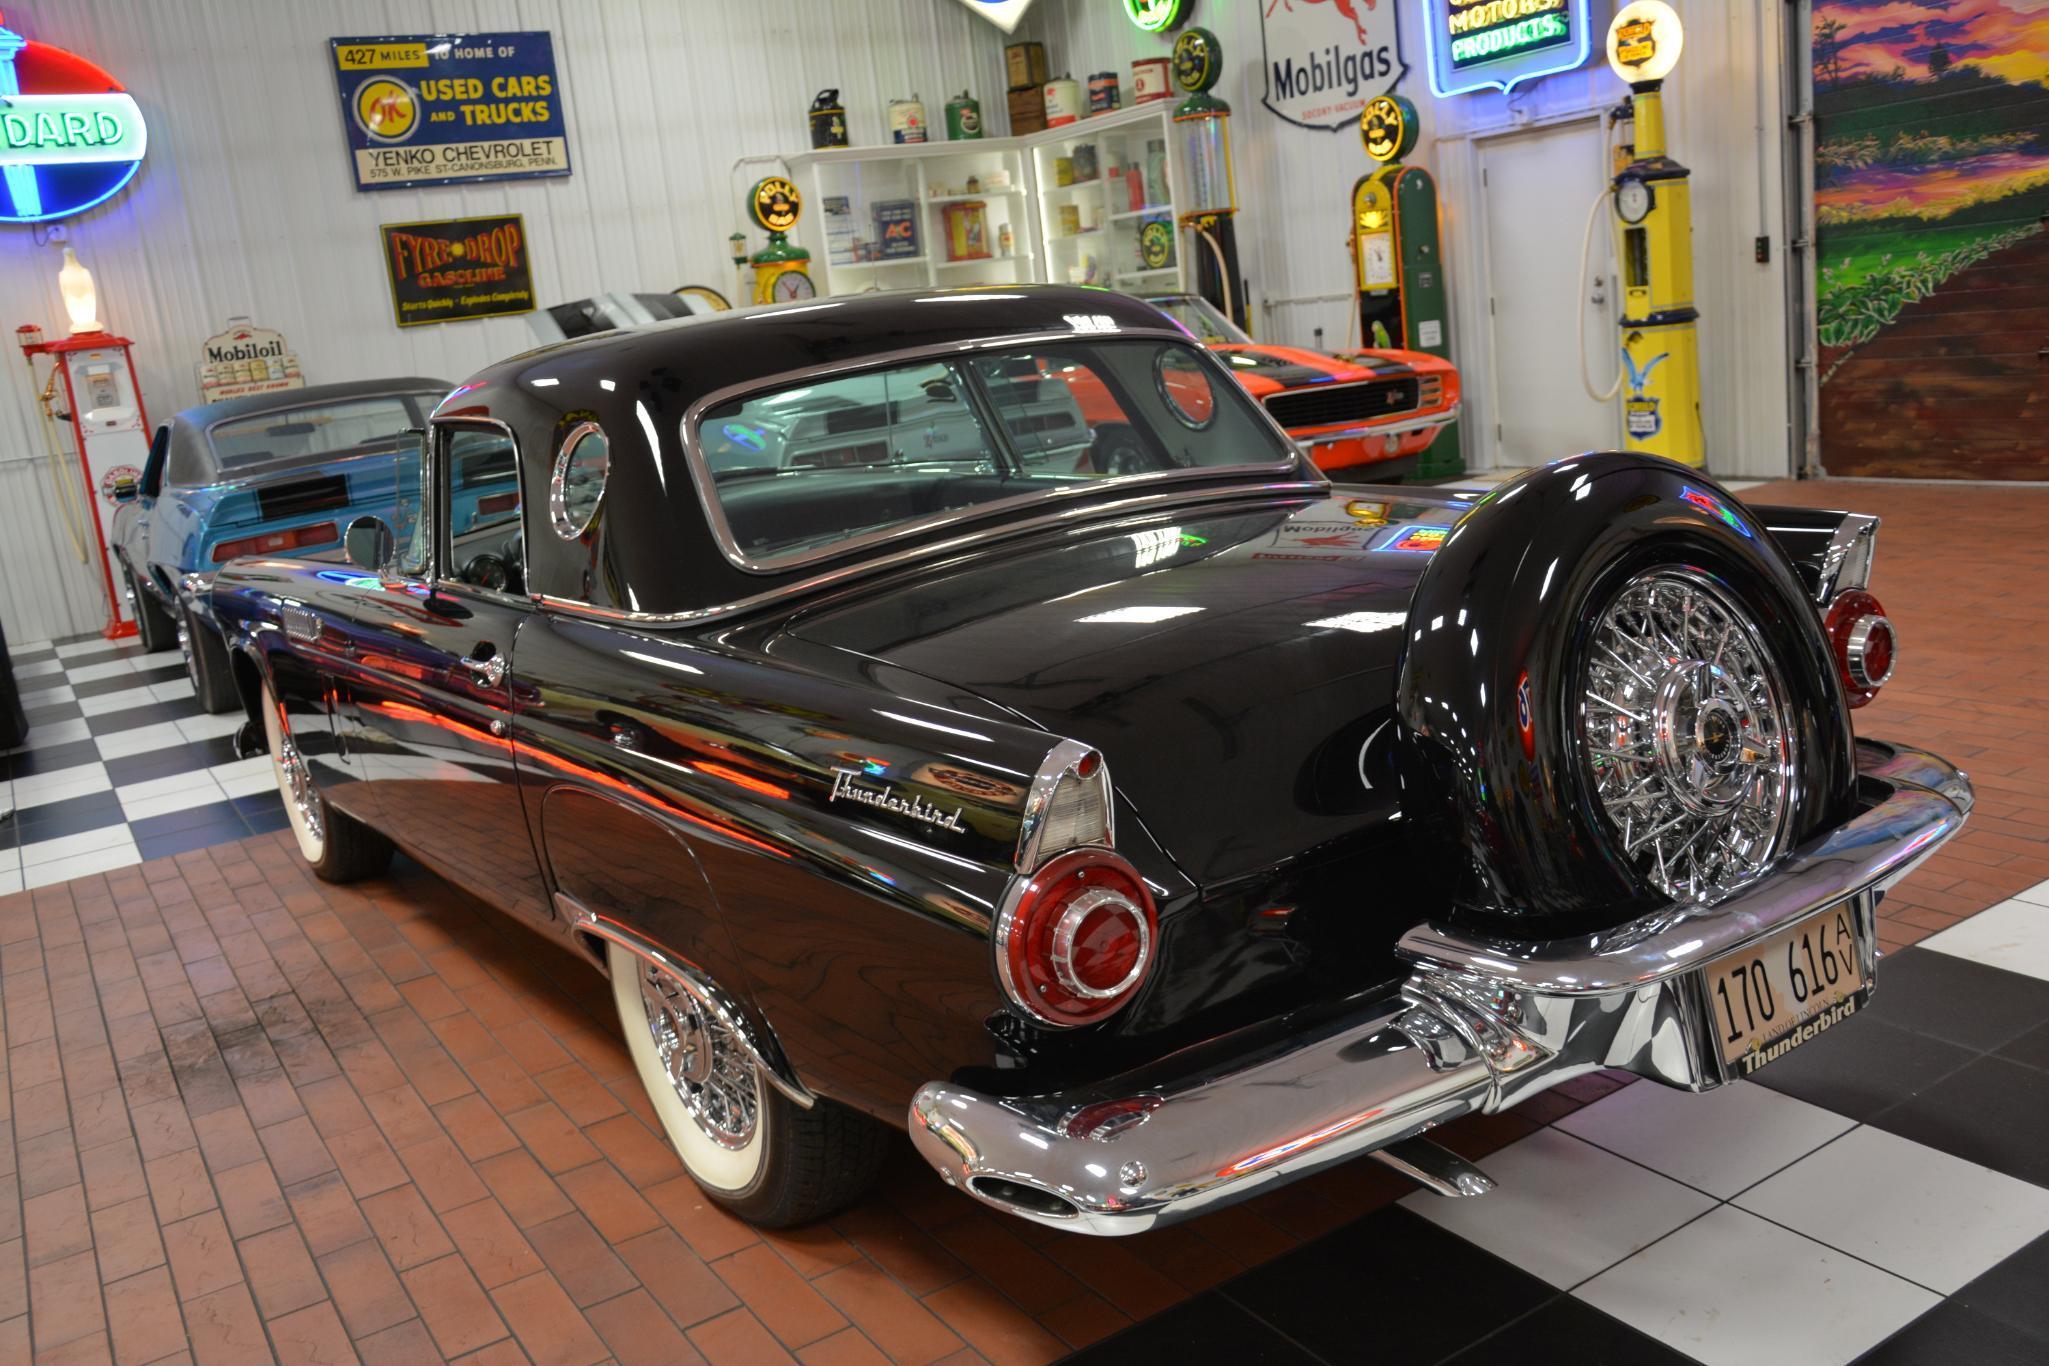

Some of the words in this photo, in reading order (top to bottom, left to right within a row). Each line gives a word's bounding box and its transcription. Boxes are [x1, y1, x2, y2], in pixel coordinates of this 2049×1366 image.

[1452, 13, 1560, 62] PRODUCTS
[344, 49, 376, 65] 427
[380, 50, 421, 61] MILES
[455, 47, 494, 59] HOME
[498, 46, 515, 58] OF
[420, 78, 484, 101] USED
[491, 75, 552, 98] CARS
[1273, 45, 1391, 102] Mobilgas
[369, 90, 406, 126] OK
[430, 111, 455, 122] AND
[460, 101, 550, 126] TRUCKS
[1362, 101, 1398, 130] POLLY
[368, 147, 435, 168] YENKO
[442, 140, 553, 163] CHEVROLET
[370, 167, 388, 178] 575
[407, 165, 431, 176] PIKE
[760, 181, 798, 204] POLLY
[391, 231, 453, 280] FYRE
[465, 223, 521, 268] DROP
[417, 267, 506, 289] GASOLINE
[207, 340, 283, 364] Mobiloil
[829, 766, 966, 834] Thunderbird
[1836, 913, 1851, 945] A
[1839, 944, 1853, 975] V
[1717, 959, 1774, 1043] 170
[1788, 924, 1838, 1003] 616
[1742, 996, 1855, 1075] Thunderbird
